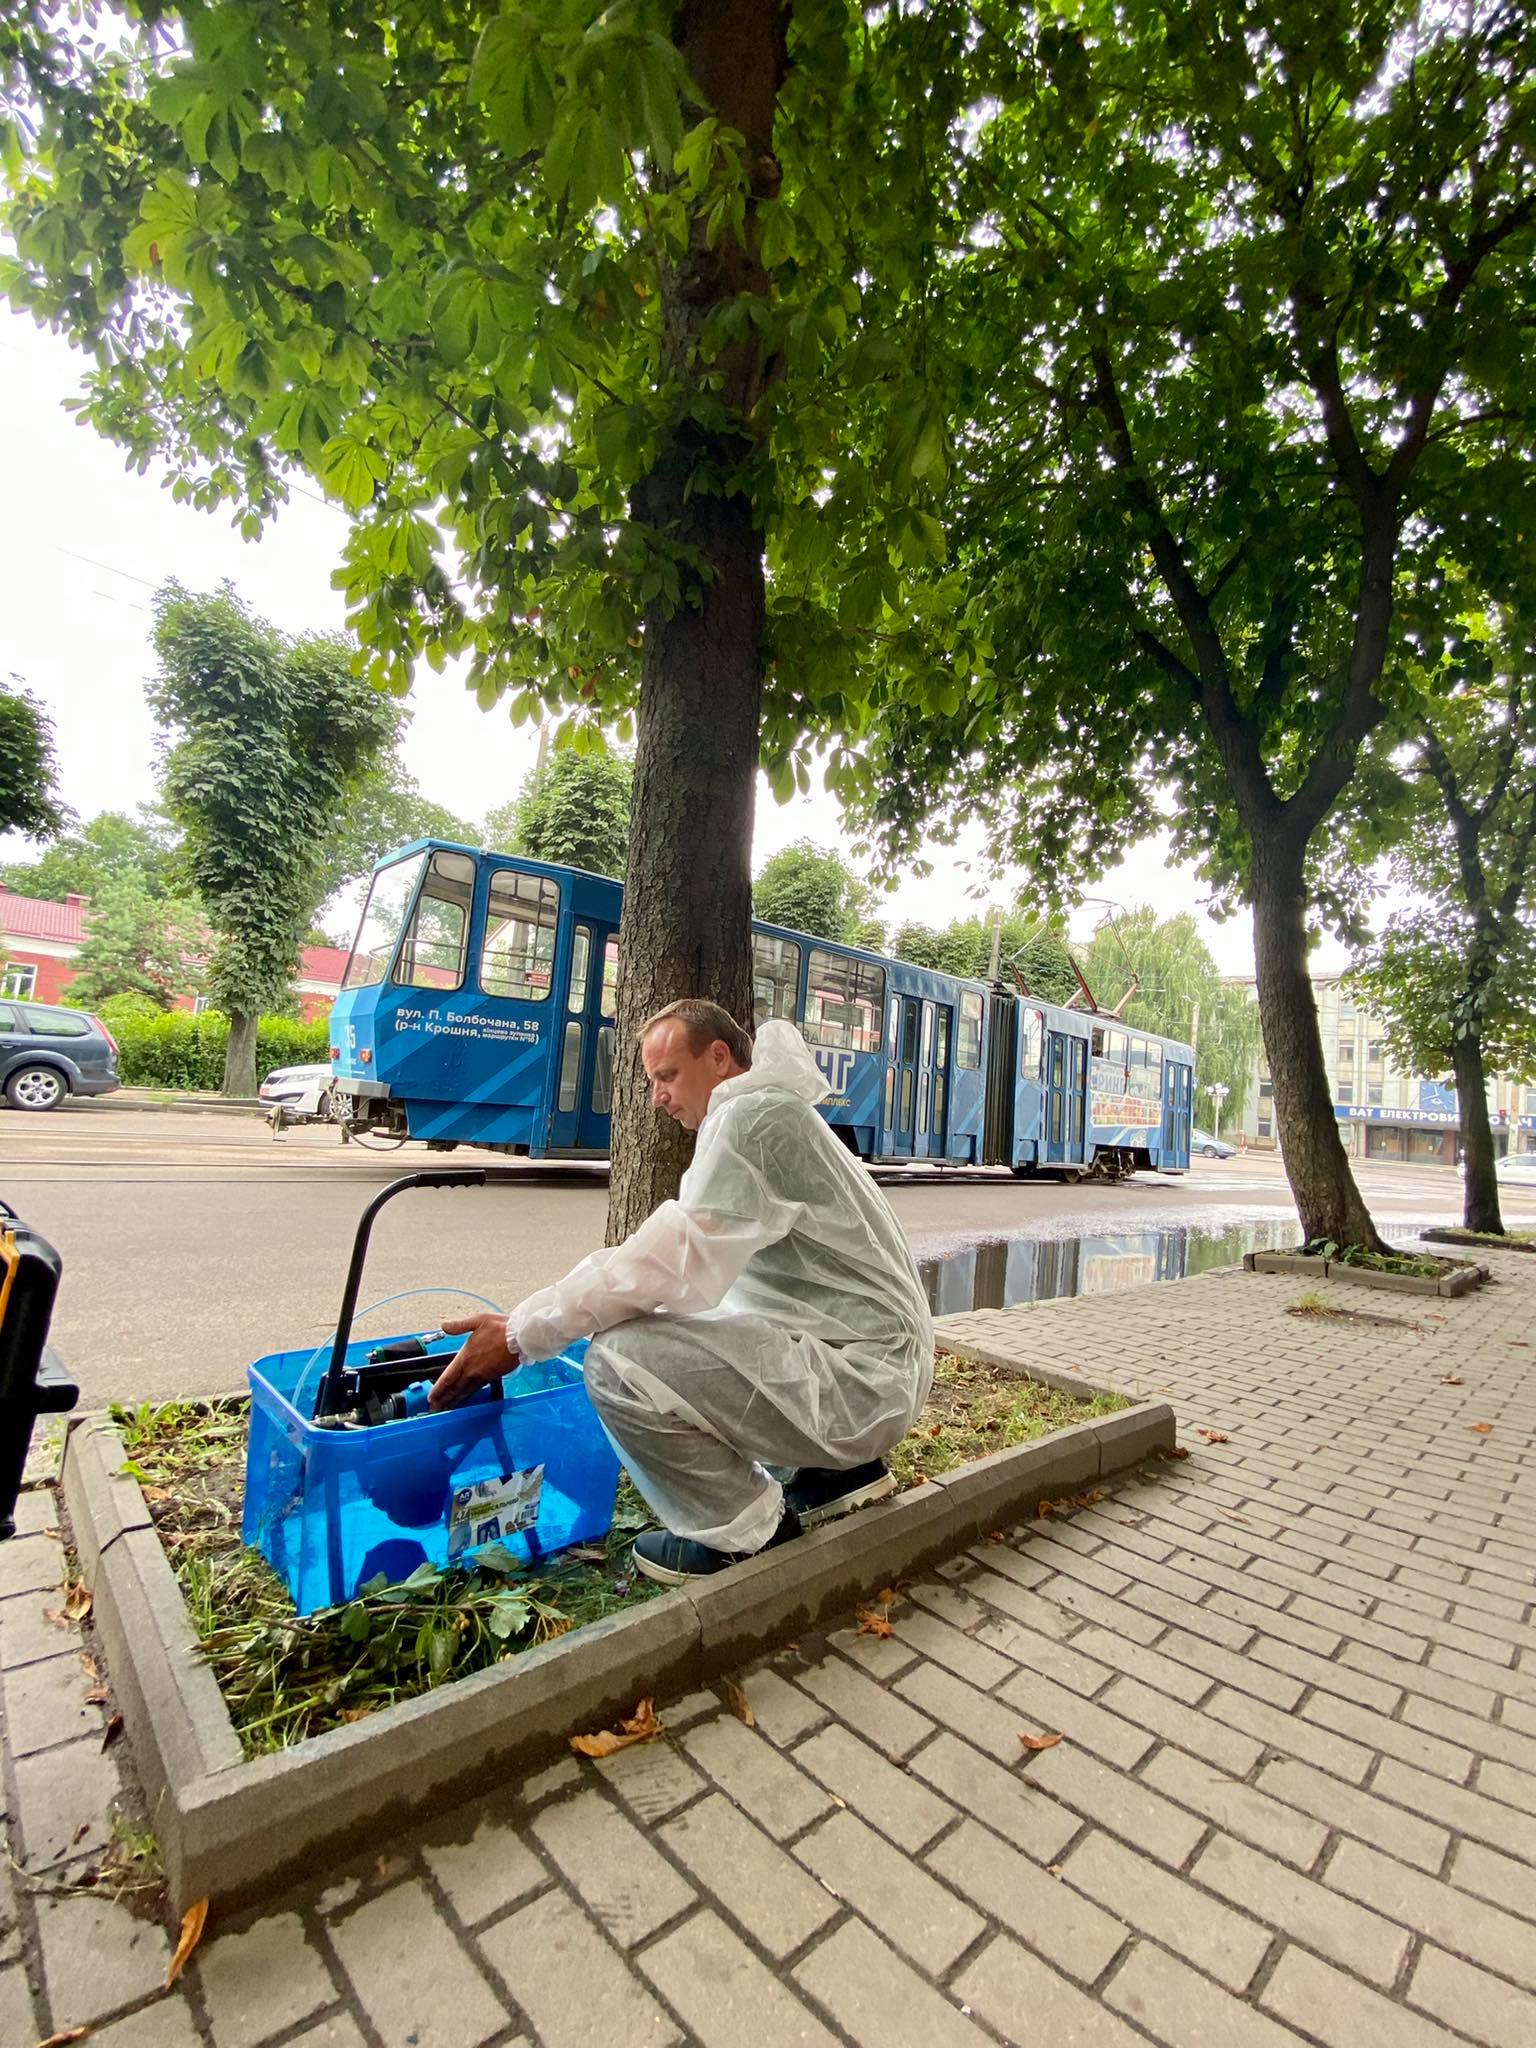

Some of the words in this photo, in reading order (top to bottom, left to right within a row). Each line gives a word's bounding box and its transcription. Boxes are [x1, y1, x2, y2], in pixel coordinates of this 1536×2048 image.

[394, 1019, 421, 1031] (р-н
[424, 1021, 481, 1039] Крошня,
[396, 1008, 425, 1020] вул.
[428, 1009, 442, 1020] П.
[446, 1011, 520, 1030] Болбочана,
[523, 1020, 540, 1031] 58
[1349, 1107, 1374, 1117] ВАТ
